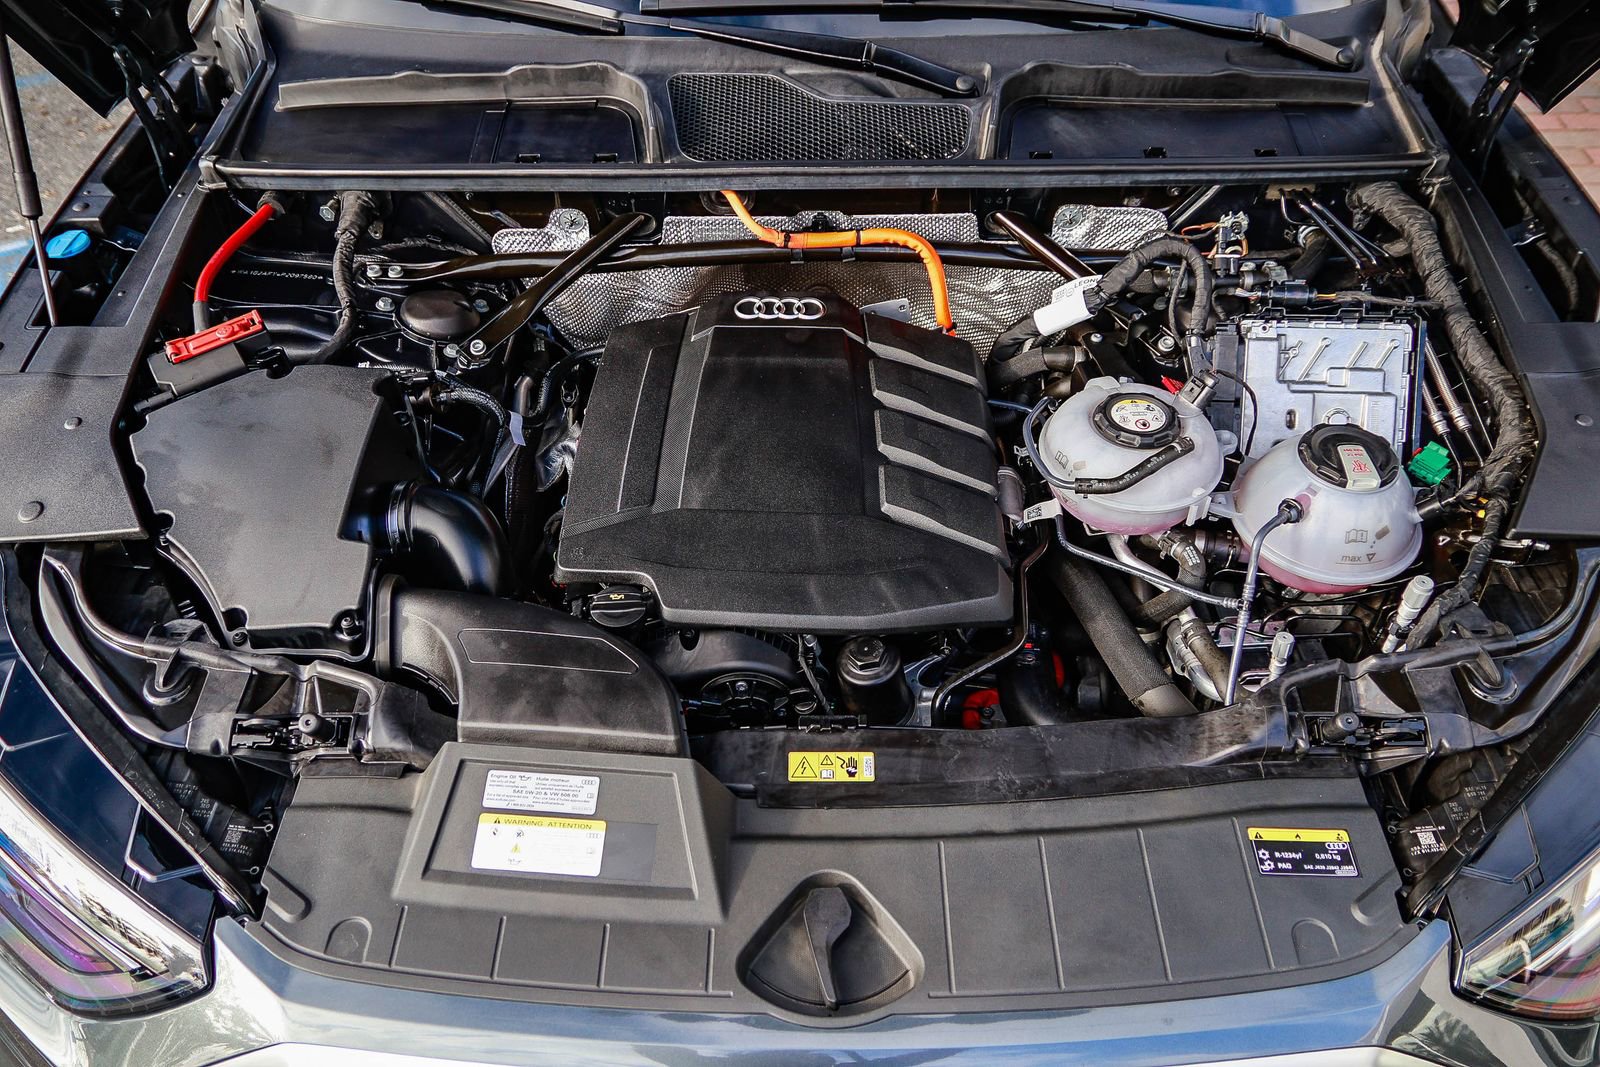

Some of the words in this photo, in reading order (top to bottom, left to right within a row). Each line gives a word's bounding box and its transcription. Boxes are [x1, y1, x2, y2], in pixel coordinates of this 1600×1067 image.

[504, 818, 543, 827] WARNING
[547, 820, 592, 830] ATTENTION
[1274, 852, 1302, 860] R-1234yf
[1332, 853, 1341, 861] kg
